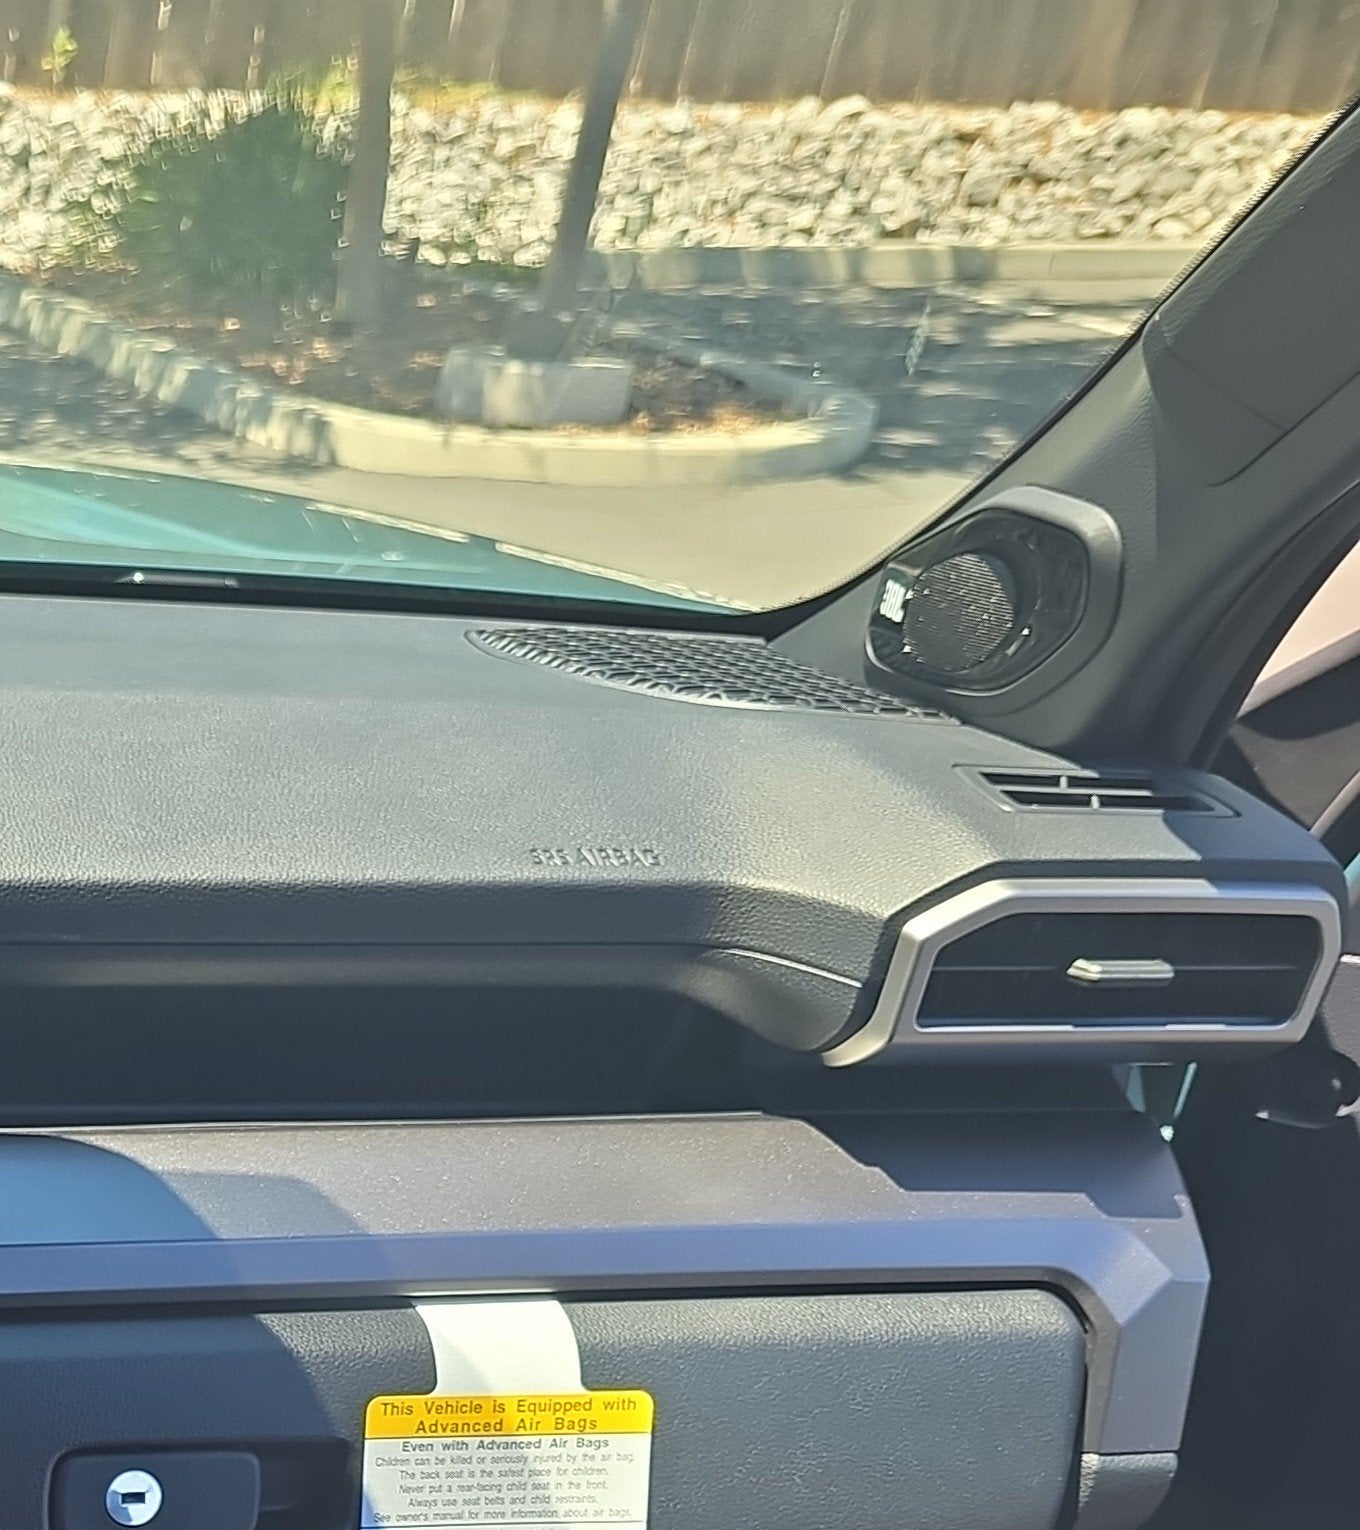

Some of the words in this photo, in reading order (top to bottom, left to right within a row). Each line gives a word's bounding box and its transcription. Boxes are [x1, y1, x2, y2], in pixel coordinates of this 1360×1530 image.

[380, 1402, 413, 1416] This
[424, 1401, 483, 1415] Vehicle
[492, 1399, 506, 1413] is
[516, 1398, 593, 1416] Equipped
[602, 1397, 637, 1411] with
[415, 1419, 503, 1434] Advanced
[515, 1417, 541, 1431] Air
[554, 1417, 597, 1432] Bags
[402, 1441, 433, 1452] Even
[441, 1440, 468, 1451] with
[476, 1439, 542, 1451] Advanced
[549, 1438, 568, 1448] Air
[576, 1438, 609, 1450] Bags
[375, 1457, 410, 1467] Children
[414, 1458, 430, 1466] can
[434, 1456, 445, 1465] be
[400, 1470, 415, 1479] The
[420, 1469, 440, 1479] back
[445, 1469, 463, 1478] seat
[480, 1468, 493, 1478] the
[498, 1468, 524, 1478] safest
[528, 1467, 551, 1478] place
[556, 1466, 568, 1476] for
[399, 1485, 425, 1494] Never
[429, 1484, 442, 1495] put
[506, 1481, 527, 1491] child
[531, 1482, 550, 1491] seat
[408, 1498, 437, 1508] Always
[441, 1499, 457, 1507] use
[462, 1497, 480, 1506] seat
[484, 1496, 505, 1506] belts
[509, 1496, 526, 1505] and
[530, 1495, 551, 1505] child
[373, 1512, 390, 1523] See
[511, 1509, 559, 1519] information
[562, 1508, 588, 1517] about
